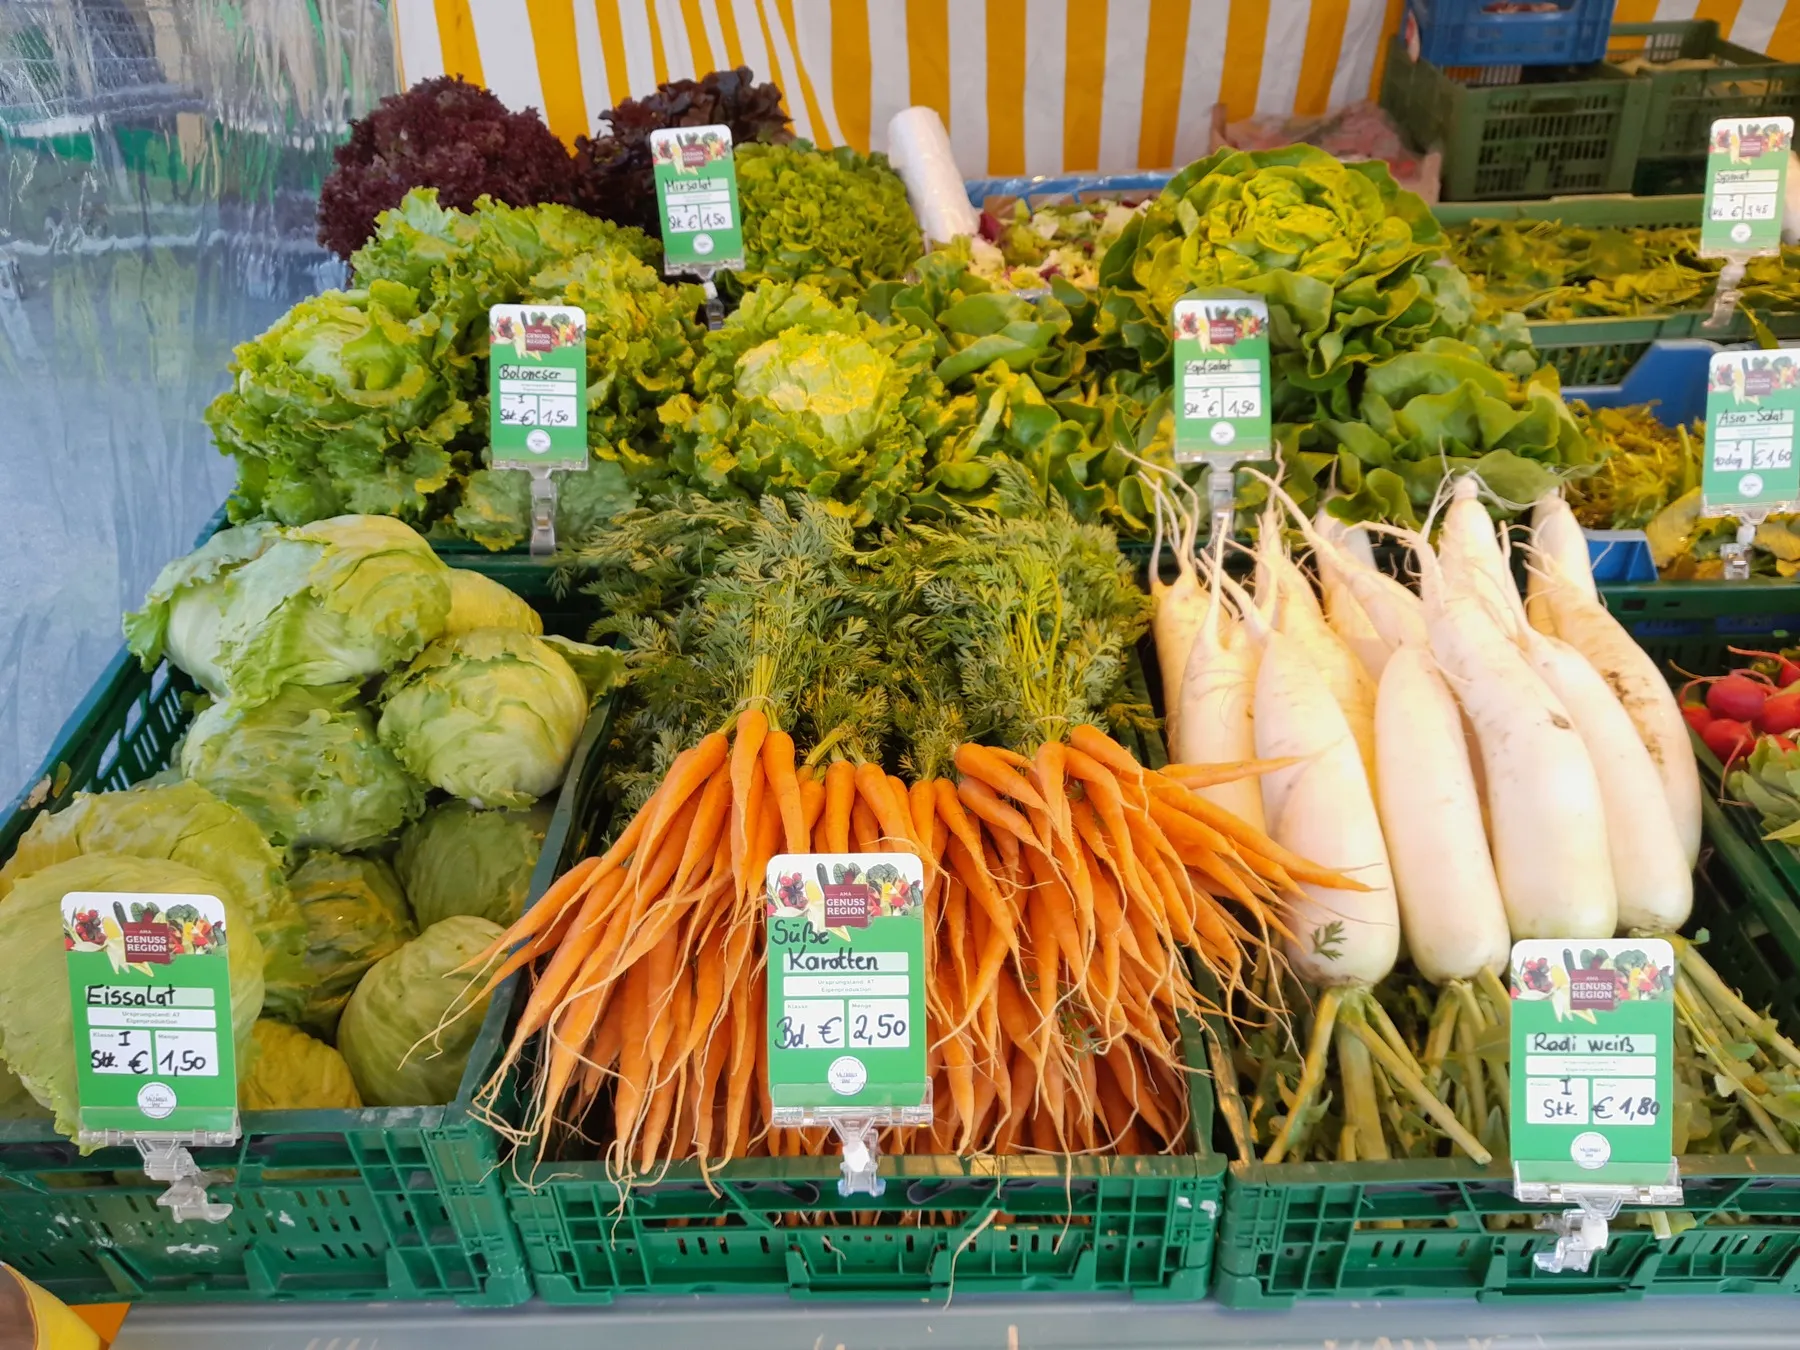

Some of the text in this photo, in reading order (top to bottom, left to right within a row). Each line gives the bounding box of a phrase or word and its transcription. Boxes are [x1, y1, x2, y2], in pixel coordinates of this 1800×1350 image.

[519, 409, 536, 427] €
[542, 409, 569, 427] 1,50
[1228, 400, 1255, 418] 1,50
[1766, 448, 1793, 468] 1,60
[826, 898, 866, 907] GENUSS
[827, 907, 865, 915] REGION
[125, 935, 167, 944] GENUSS
[771, 919, 830, 946] Süße
[127, 943, 167, 952] REGION
[788, 945, 879, 971] Karotten
[86, 984, 176, 1006] Eissalat
[1572, 982, 1613, 991] GENUSS
[1572, 990, 1612, 999] REGION
[118, 1031, 131, 1046] I
[774, 1013, 907, 1049] Bd. € 2,50
[1534, 1032, 1577, 1052] Radi
[128, 1050, 148, 1074] €
[159, 1050, 206, 1077] 1,50
[1559, 1076, 1572, 1095] I
[1591, 1096, 1614, 1119] €
[1619, 1096, 1661, 1121] 1,80
